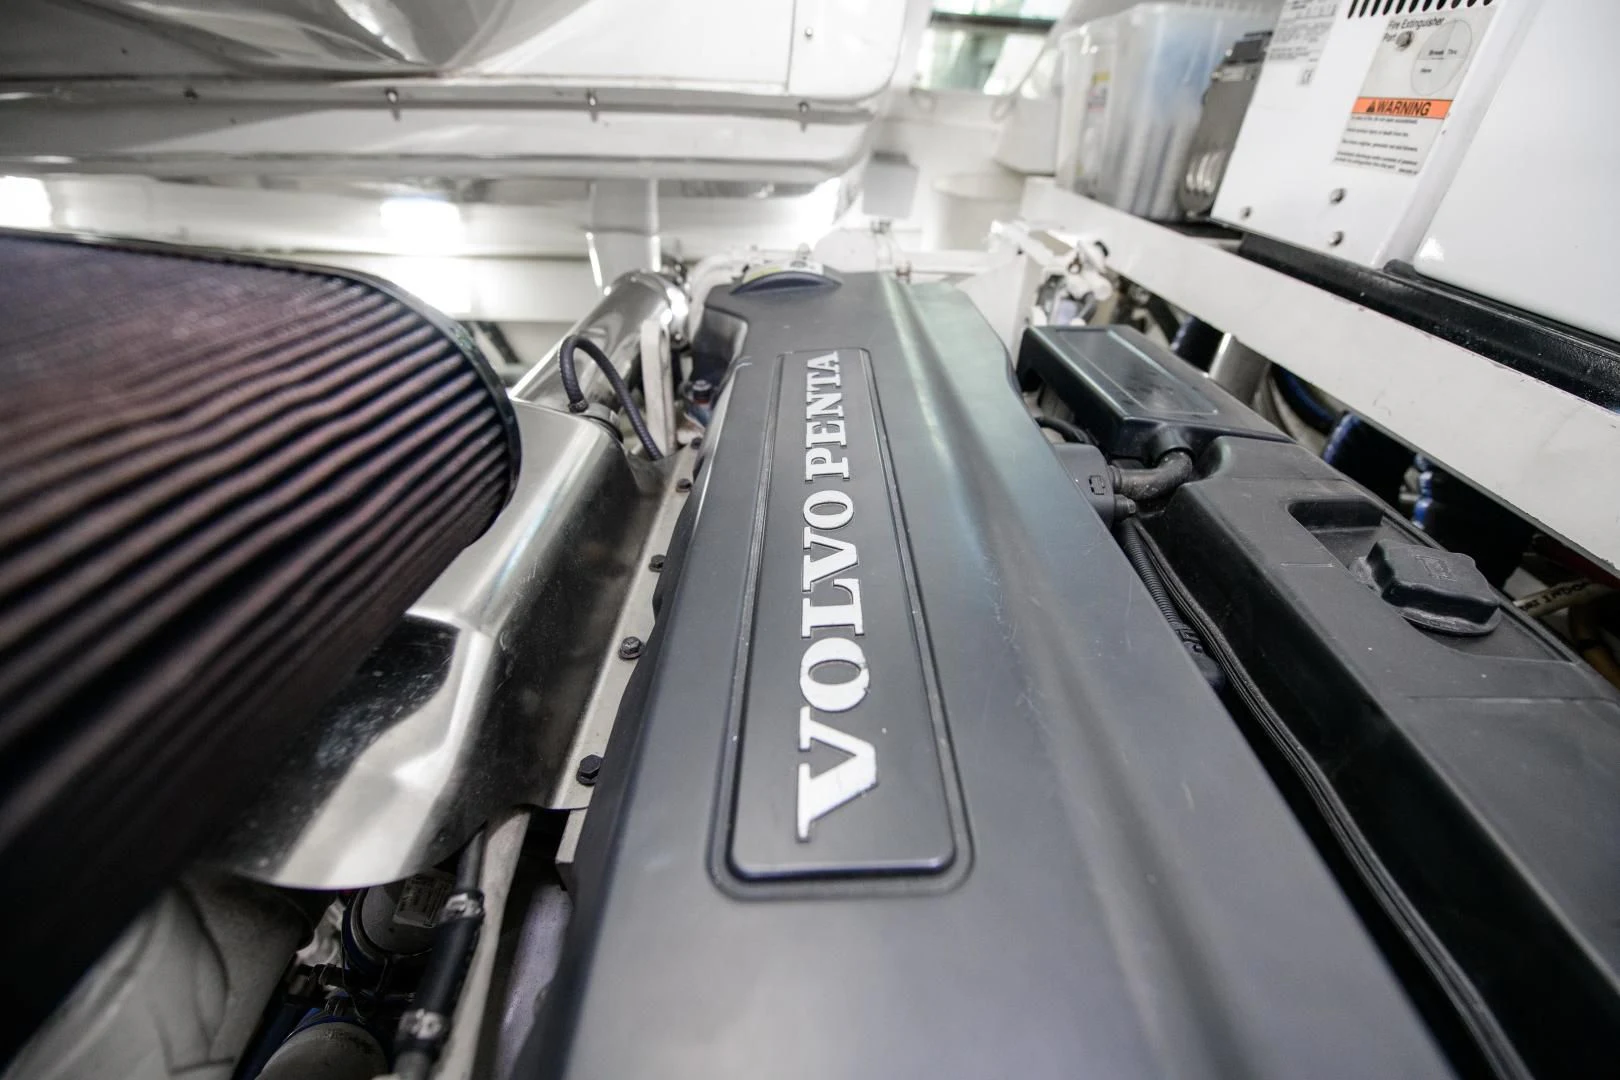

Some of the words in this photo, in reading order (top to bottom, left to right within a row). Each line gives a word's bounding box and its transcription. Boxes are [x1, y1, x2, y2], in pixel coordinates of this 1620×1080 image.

[1401, 16, 1445, 31] Extinguisher
[1376, 101, 1431, 116] WARNING
[805, 351, 850, 481] PENTA
[797, 490, 878, 840] VOLVO
